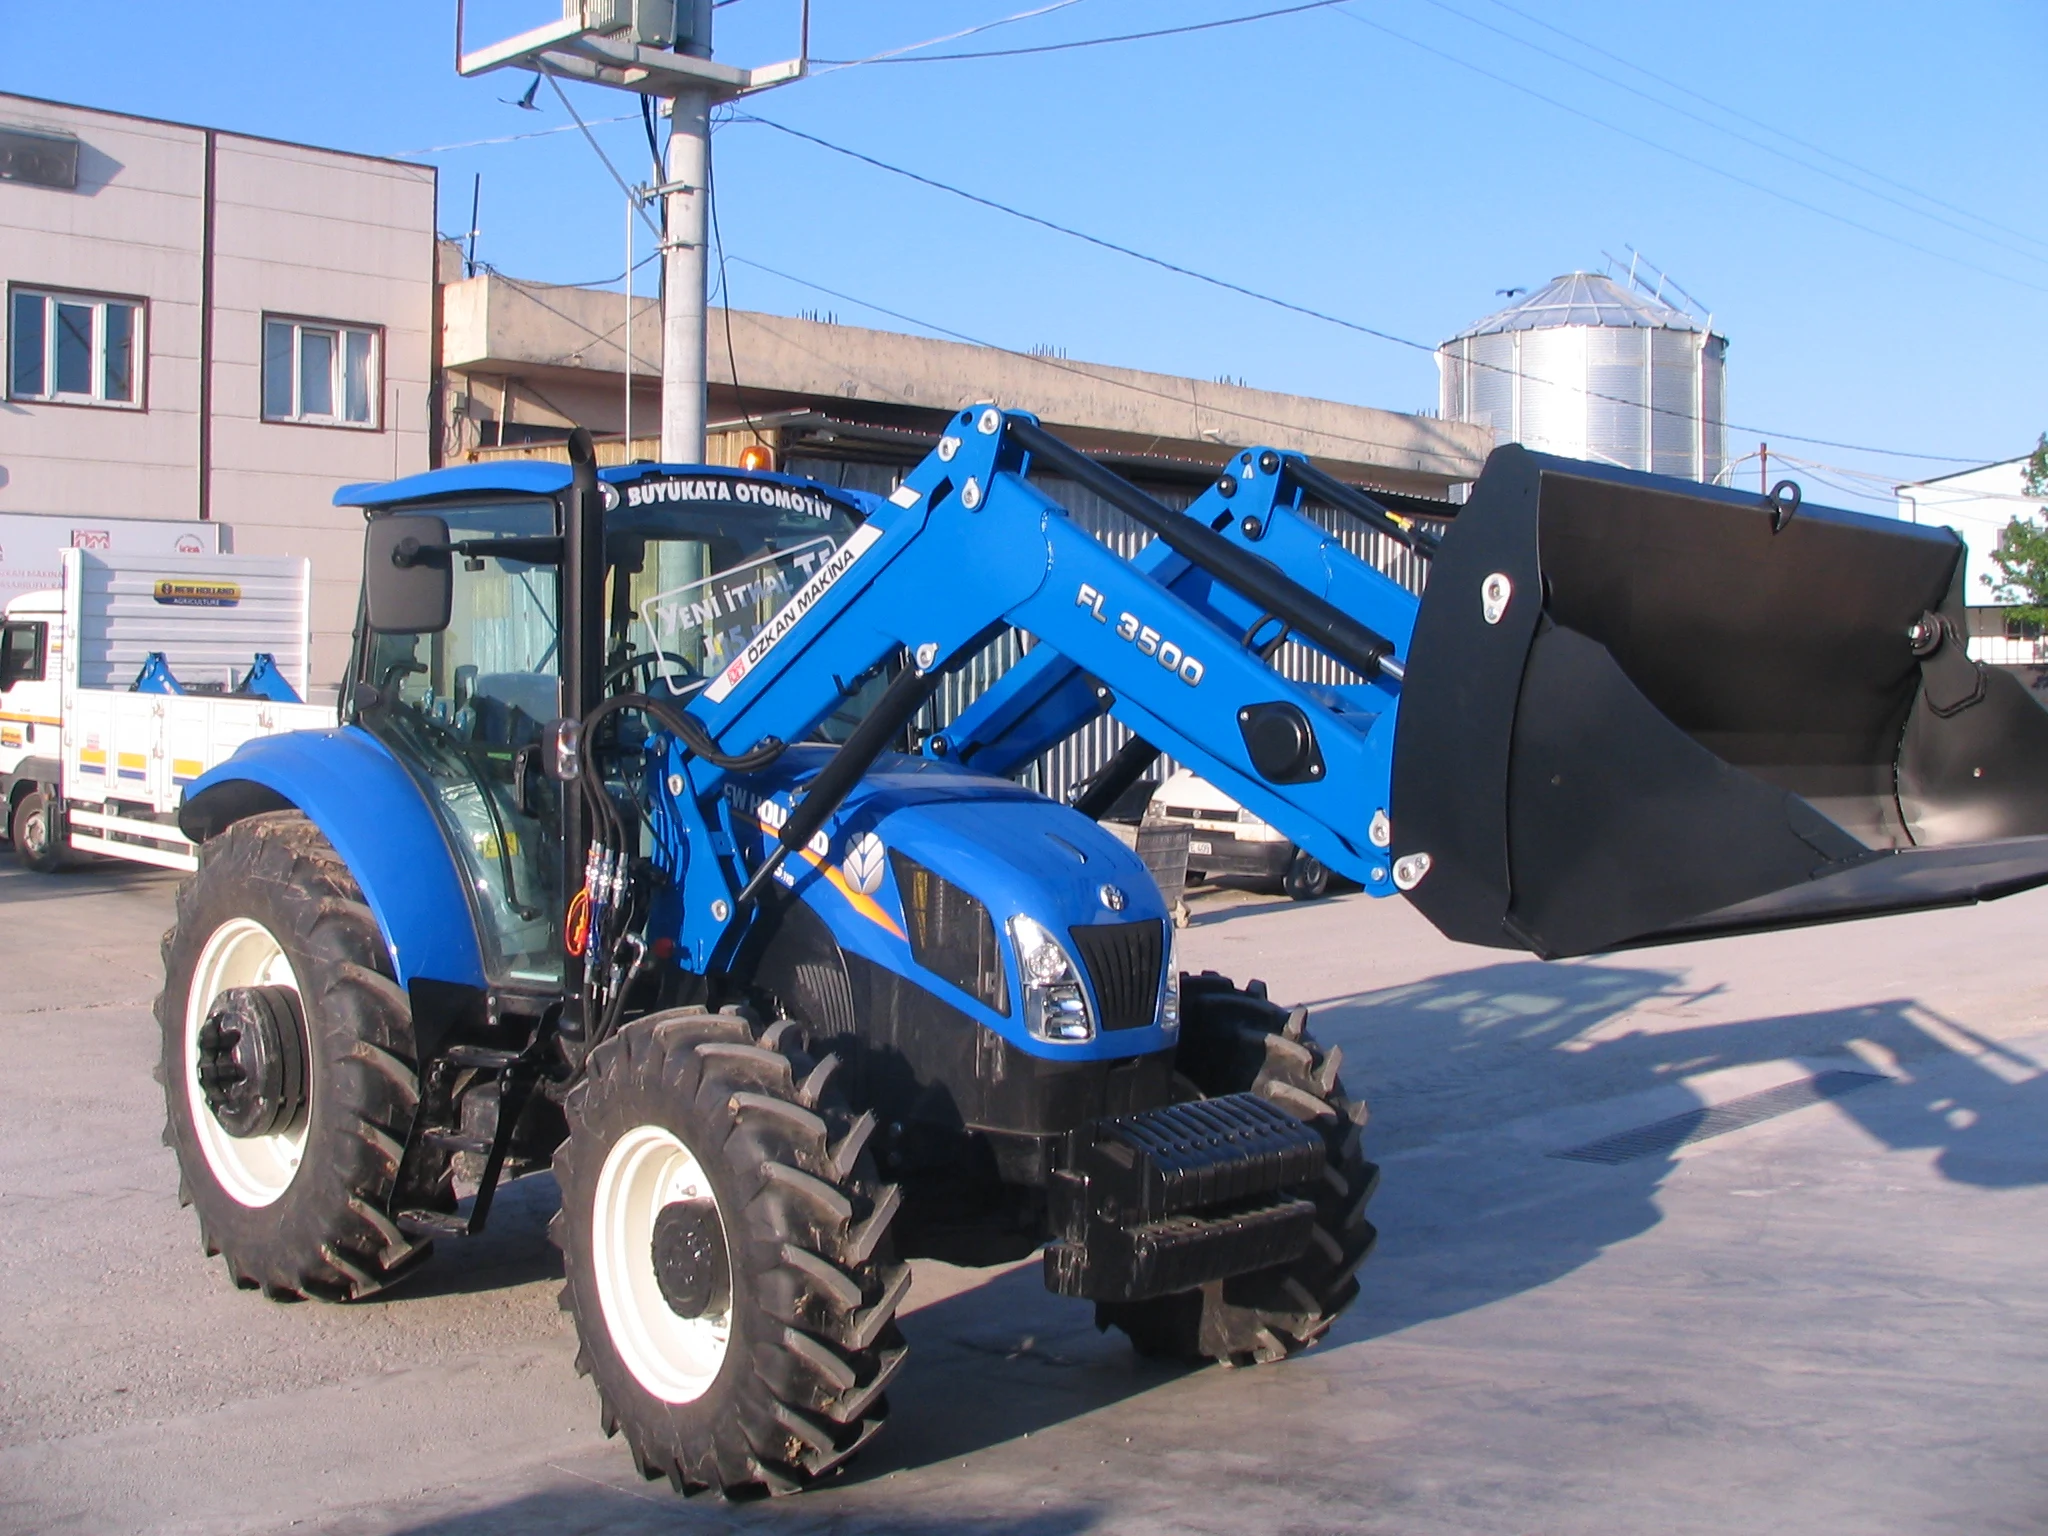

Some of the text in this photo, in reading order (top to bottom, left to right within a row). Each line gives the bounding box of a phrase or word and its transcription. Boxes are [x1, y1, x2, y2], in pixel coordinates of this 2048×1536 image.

[627, 477, 833, 521] BÜYÜKATA OTOMOTİV
[173, 597, 219, 606] AGRICULTURE
[196, 587, 235, 595] HOLLAND
[654, 589, 723, 637] YENİ
[747, 548, 855, 665] ÖZKAN MAKİNA
[1075, 582, 1205, 687] FL 3500
[749, 793, 830, 858] HOLLD
